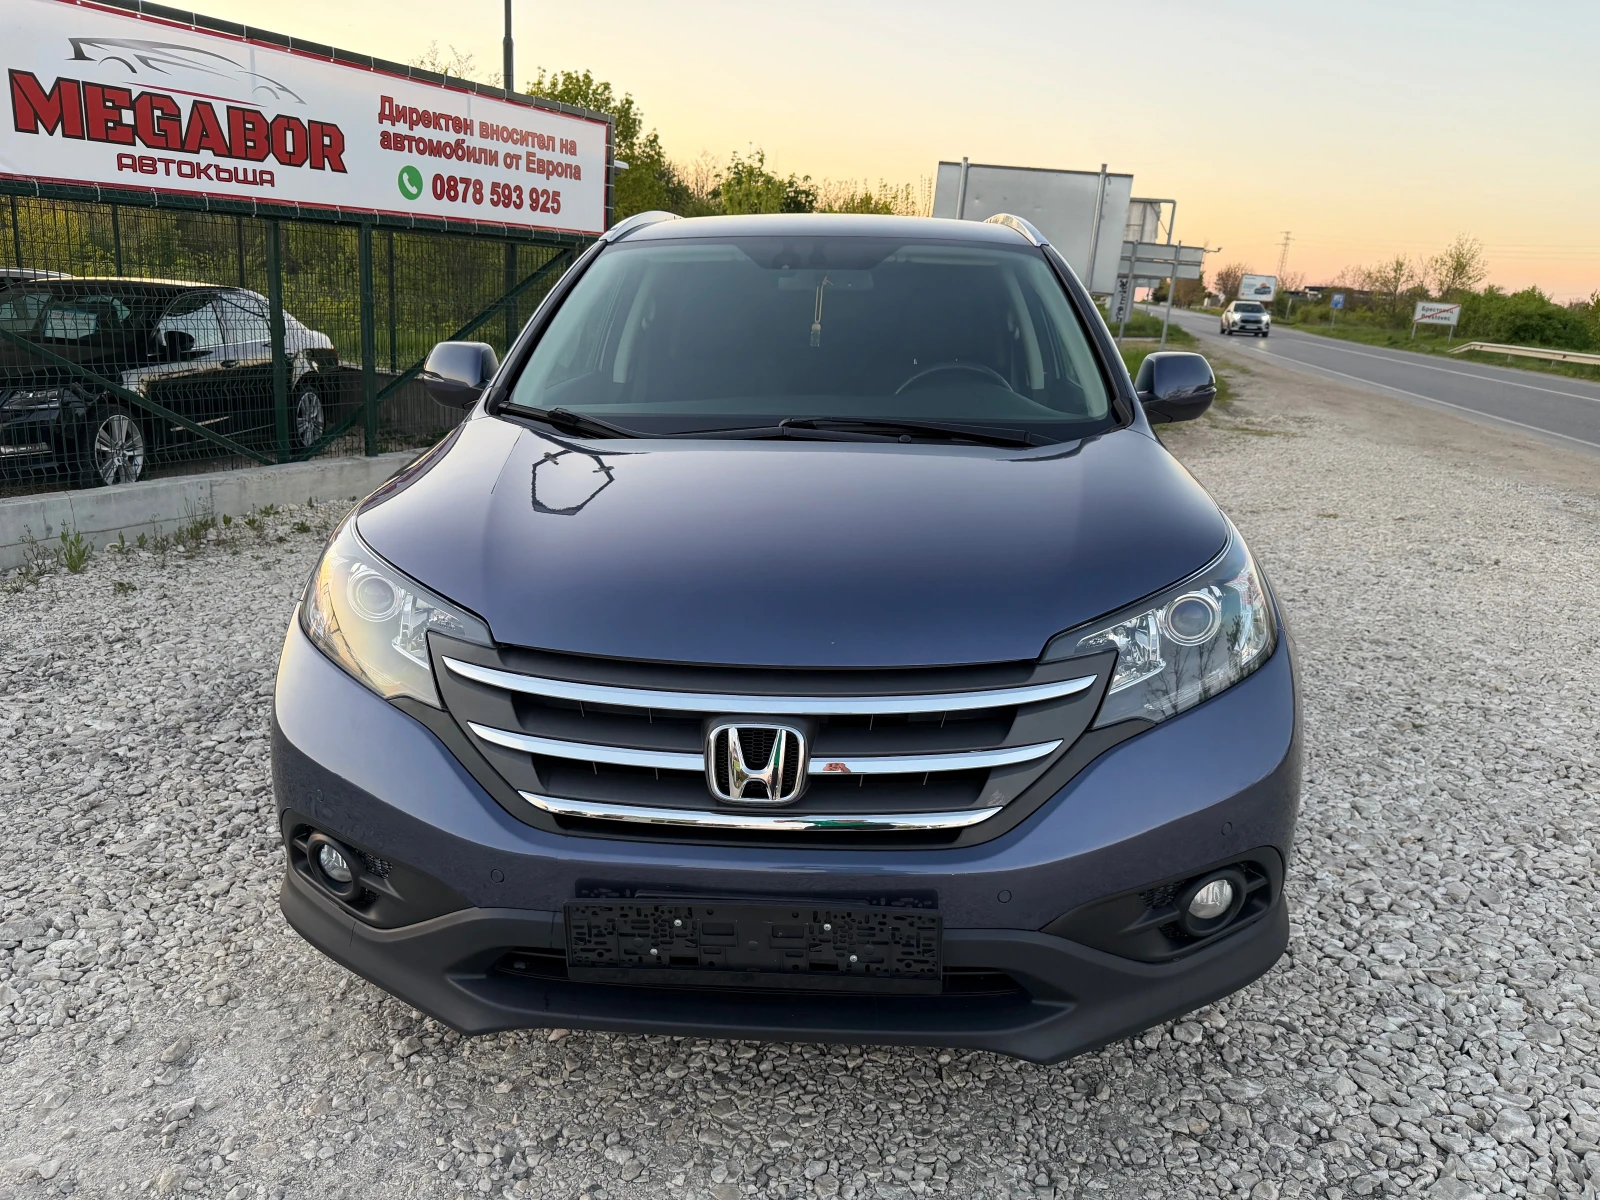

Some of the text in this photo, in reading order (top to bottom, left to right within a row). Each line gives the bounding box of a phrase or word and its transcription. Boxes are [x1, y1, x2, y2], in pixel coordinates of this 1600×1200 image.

[8, 68, 348, 174] MEGABOR
[378, 95, 577, 156] Директен вносител на
[116, 153, 275, 188] АВТОКЪЩА
[380, 131, 582, 181] автомобили от Европа
[432, 173, 561, 214] 0878 593 925
